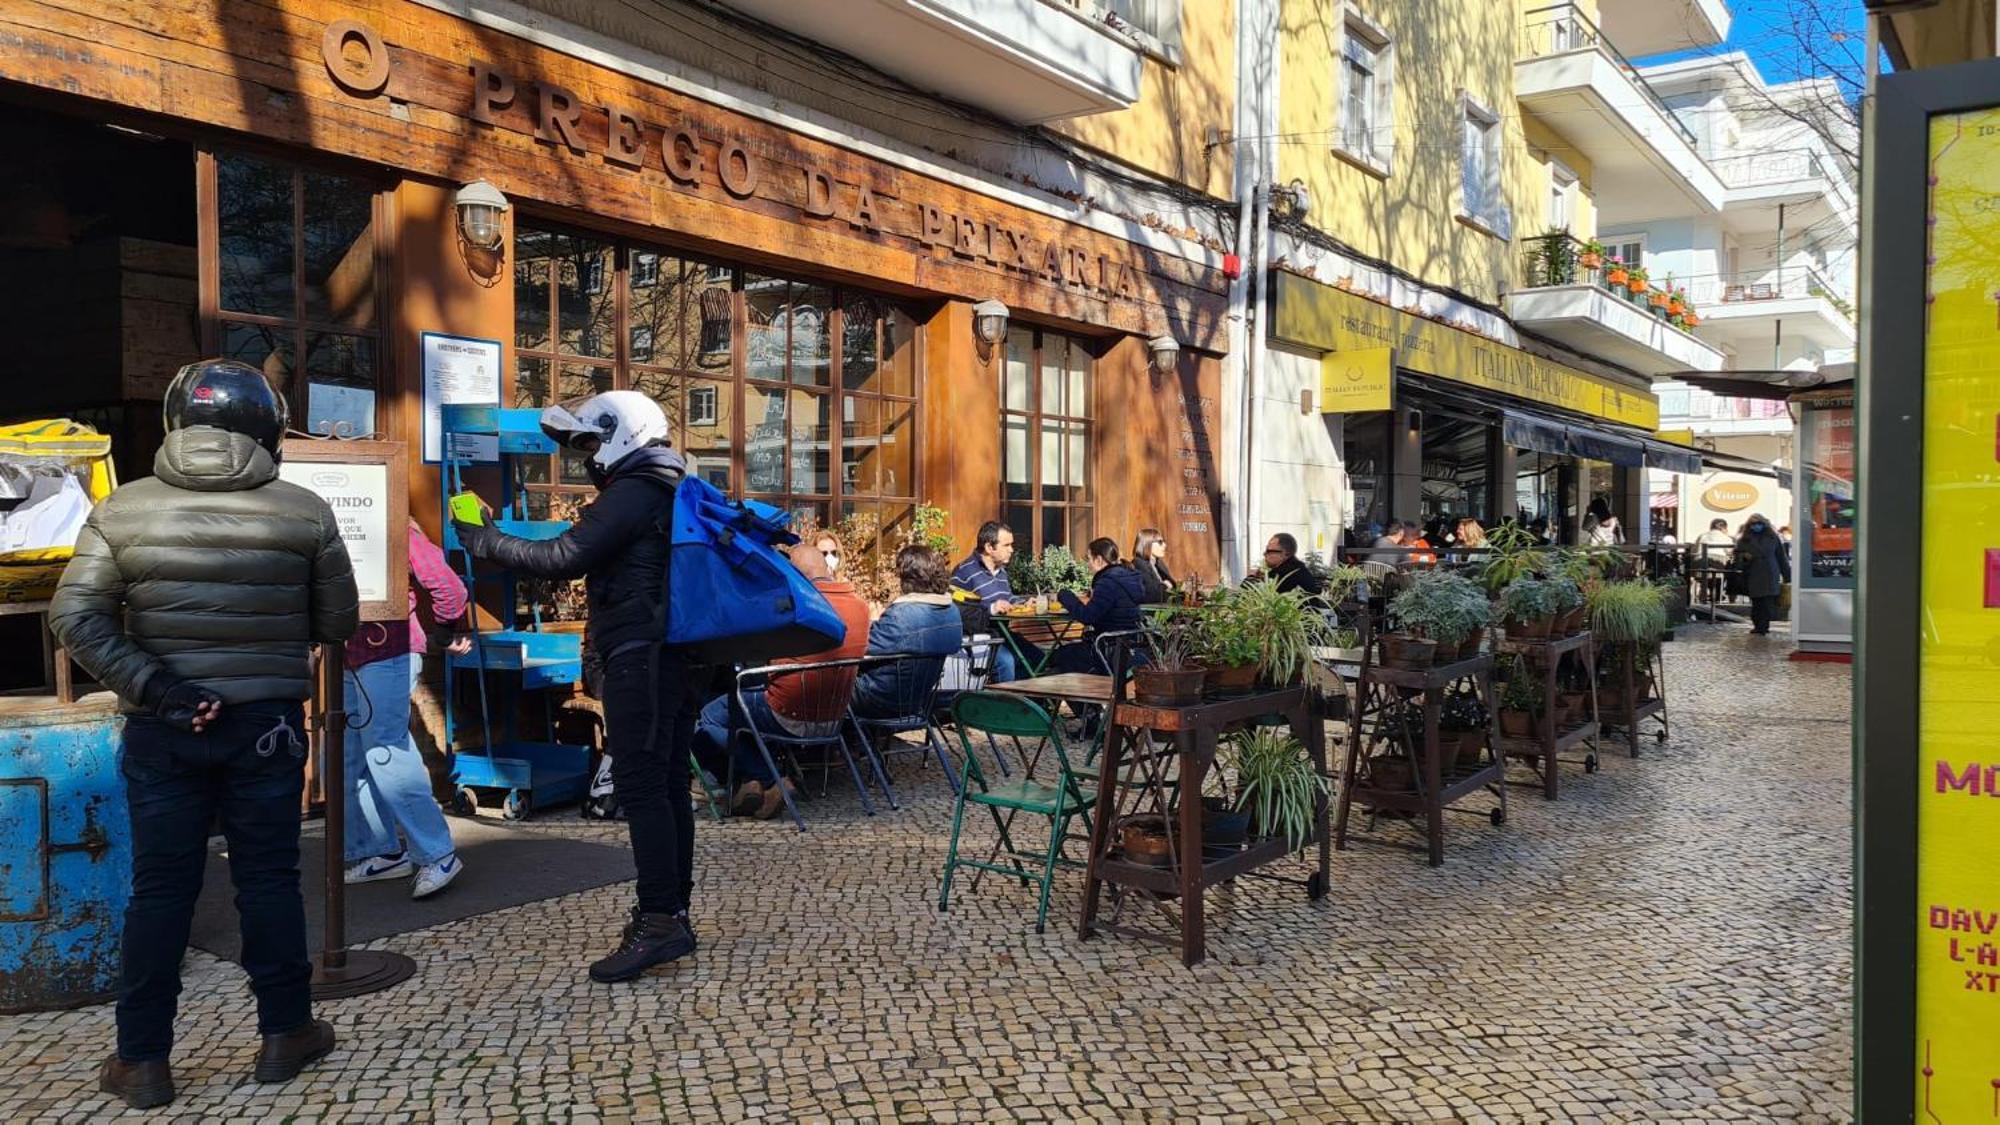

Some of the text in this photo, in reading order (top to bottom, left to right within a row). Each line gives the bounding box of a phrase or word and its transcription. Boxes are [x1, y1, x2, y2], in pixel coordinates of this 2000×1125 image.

[322, 18, 1136, 297] O PREGO DA PEIXARIA
[1340, 315, 1393, 343] restaurant
[1473, 346, 1523, 386] ITALIAN
